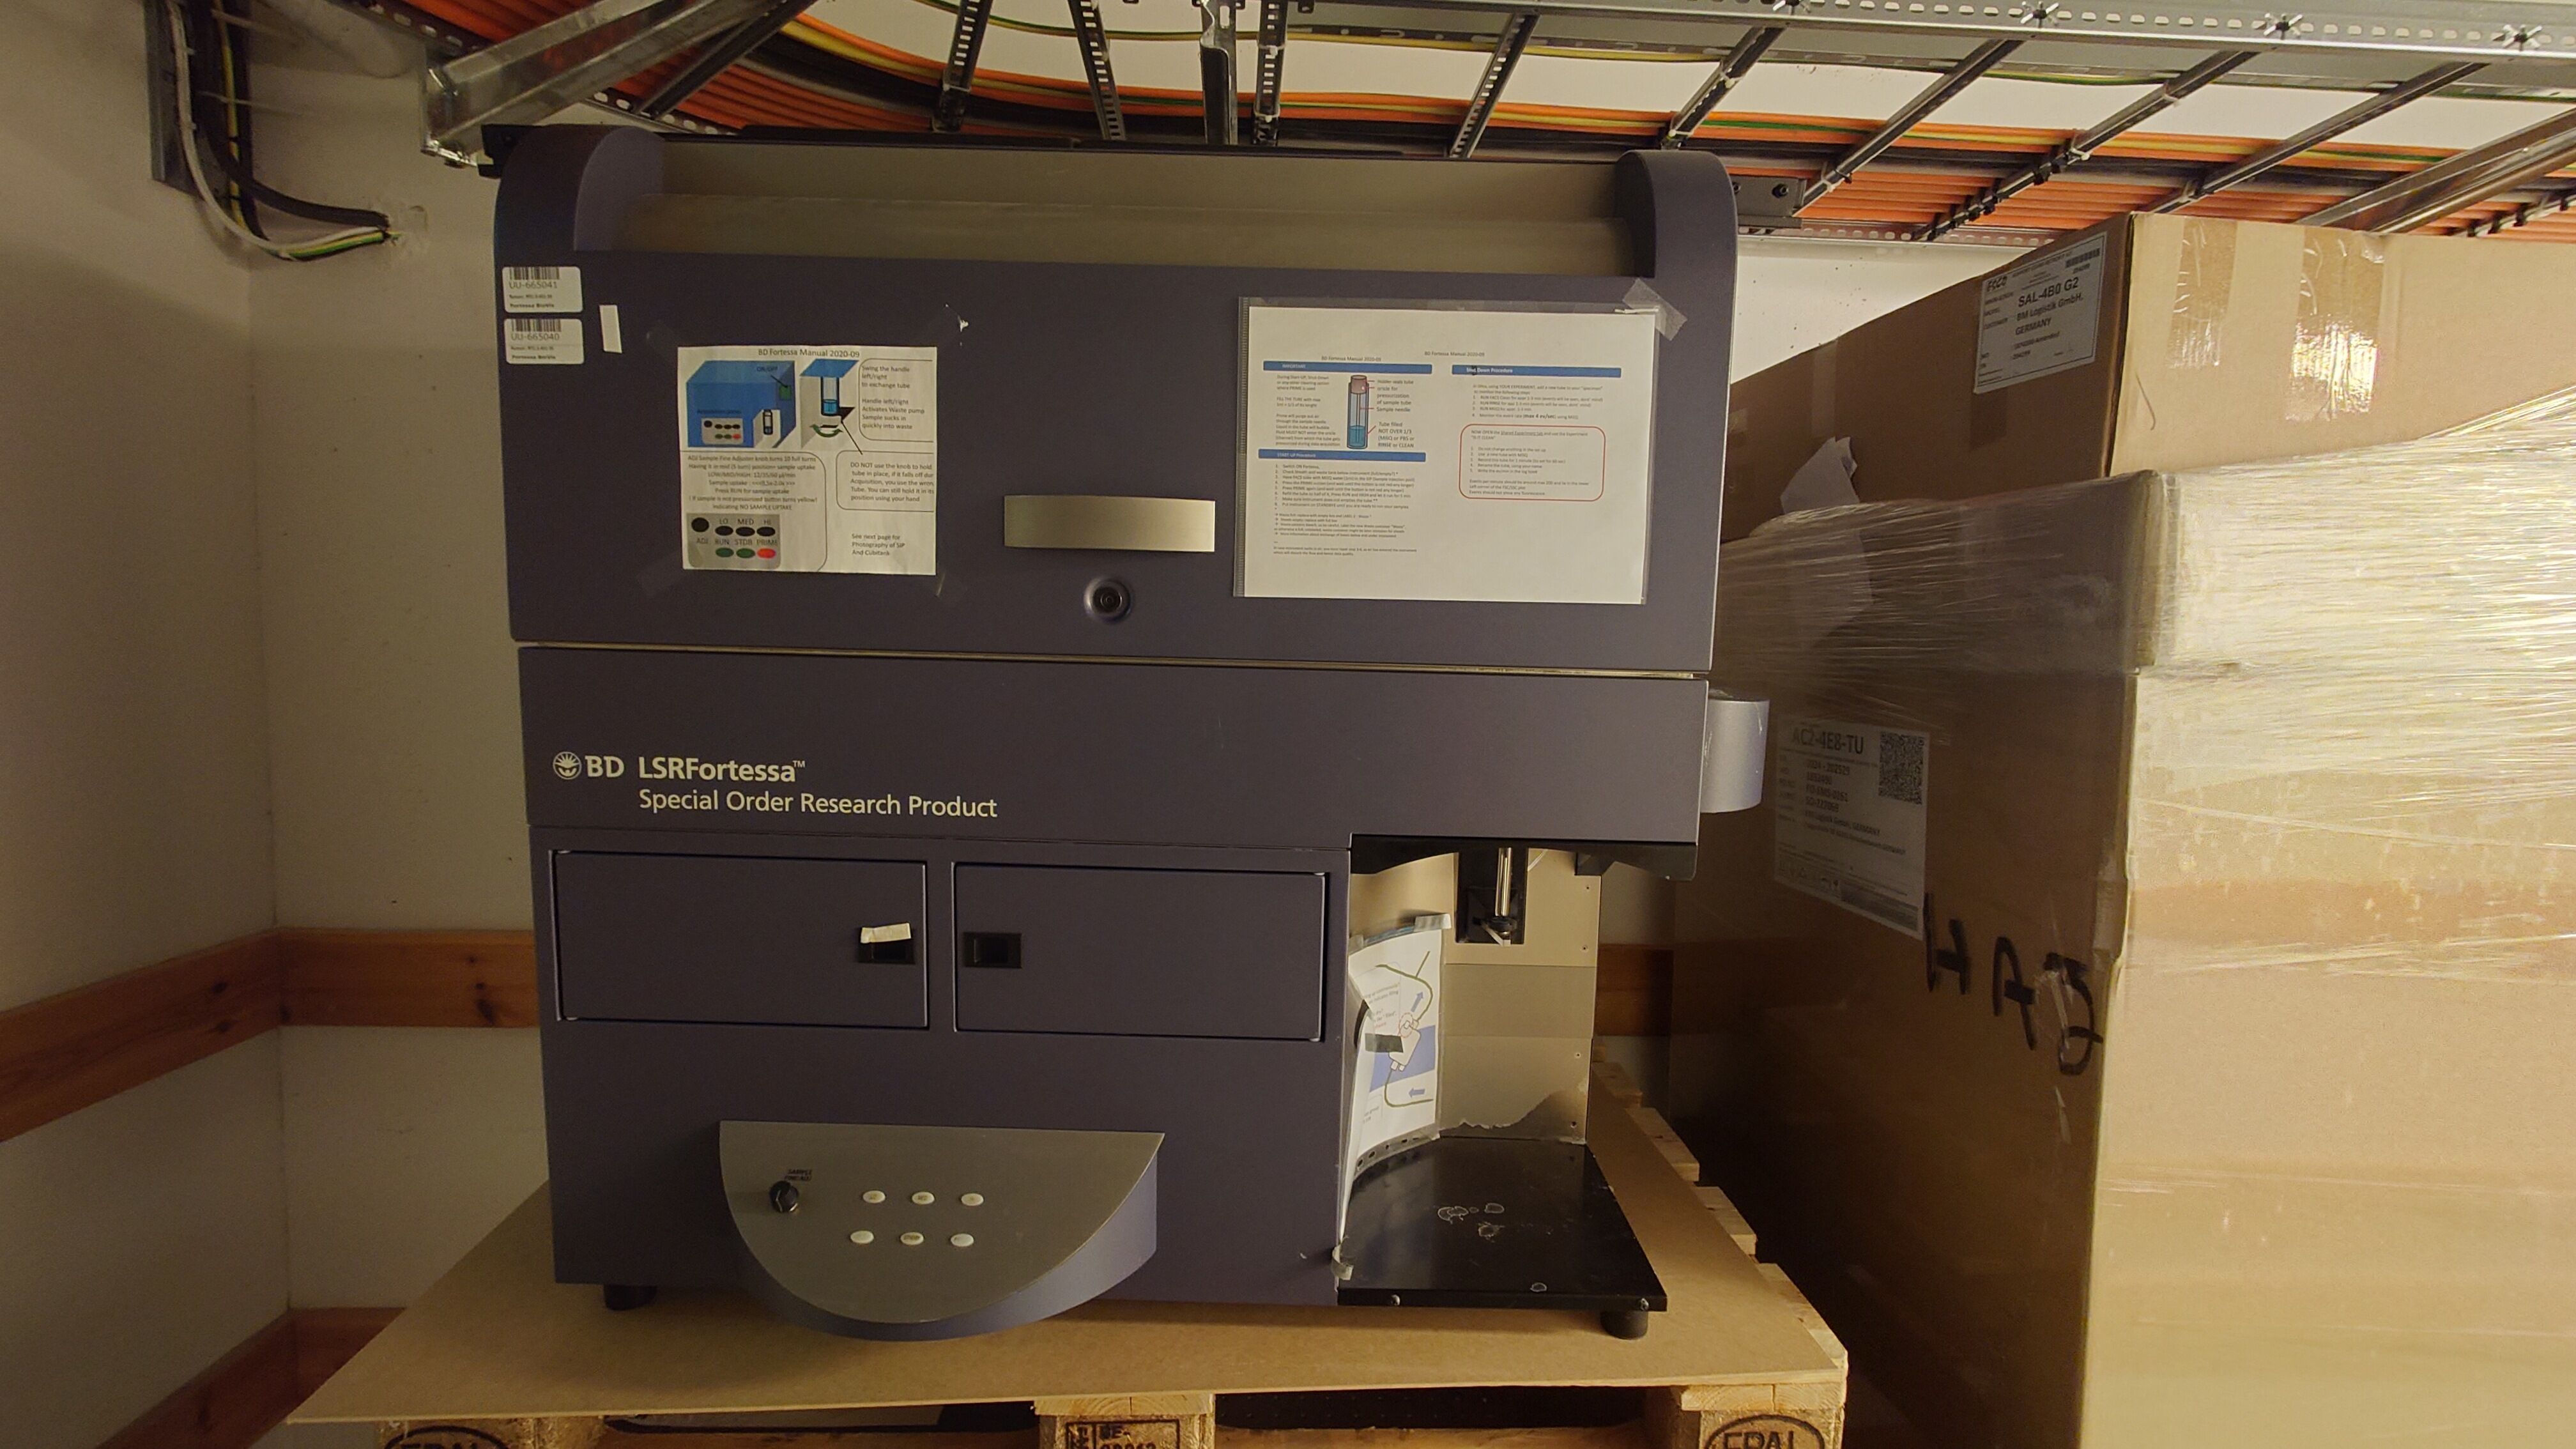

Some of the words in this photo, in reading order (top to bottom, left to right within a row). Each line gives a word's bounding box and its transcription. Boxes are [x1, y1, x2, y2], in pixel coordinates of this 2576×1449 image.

[2064, 277, 2079, 291] G2
[2030, 301, 2057, 317] Logistik
[2015, 317, 2051, 335] GERMANY
[800, 349, 828, 357] Manual
[830, 349, 860, 358] 2020-09
[585, 755, 624, 778] BD
[640, 789, 718, 813] Special
[726, 791, 793, 812] Order
[801, 793, 901, 815] Research
[909, 796, 998, 818] Product
